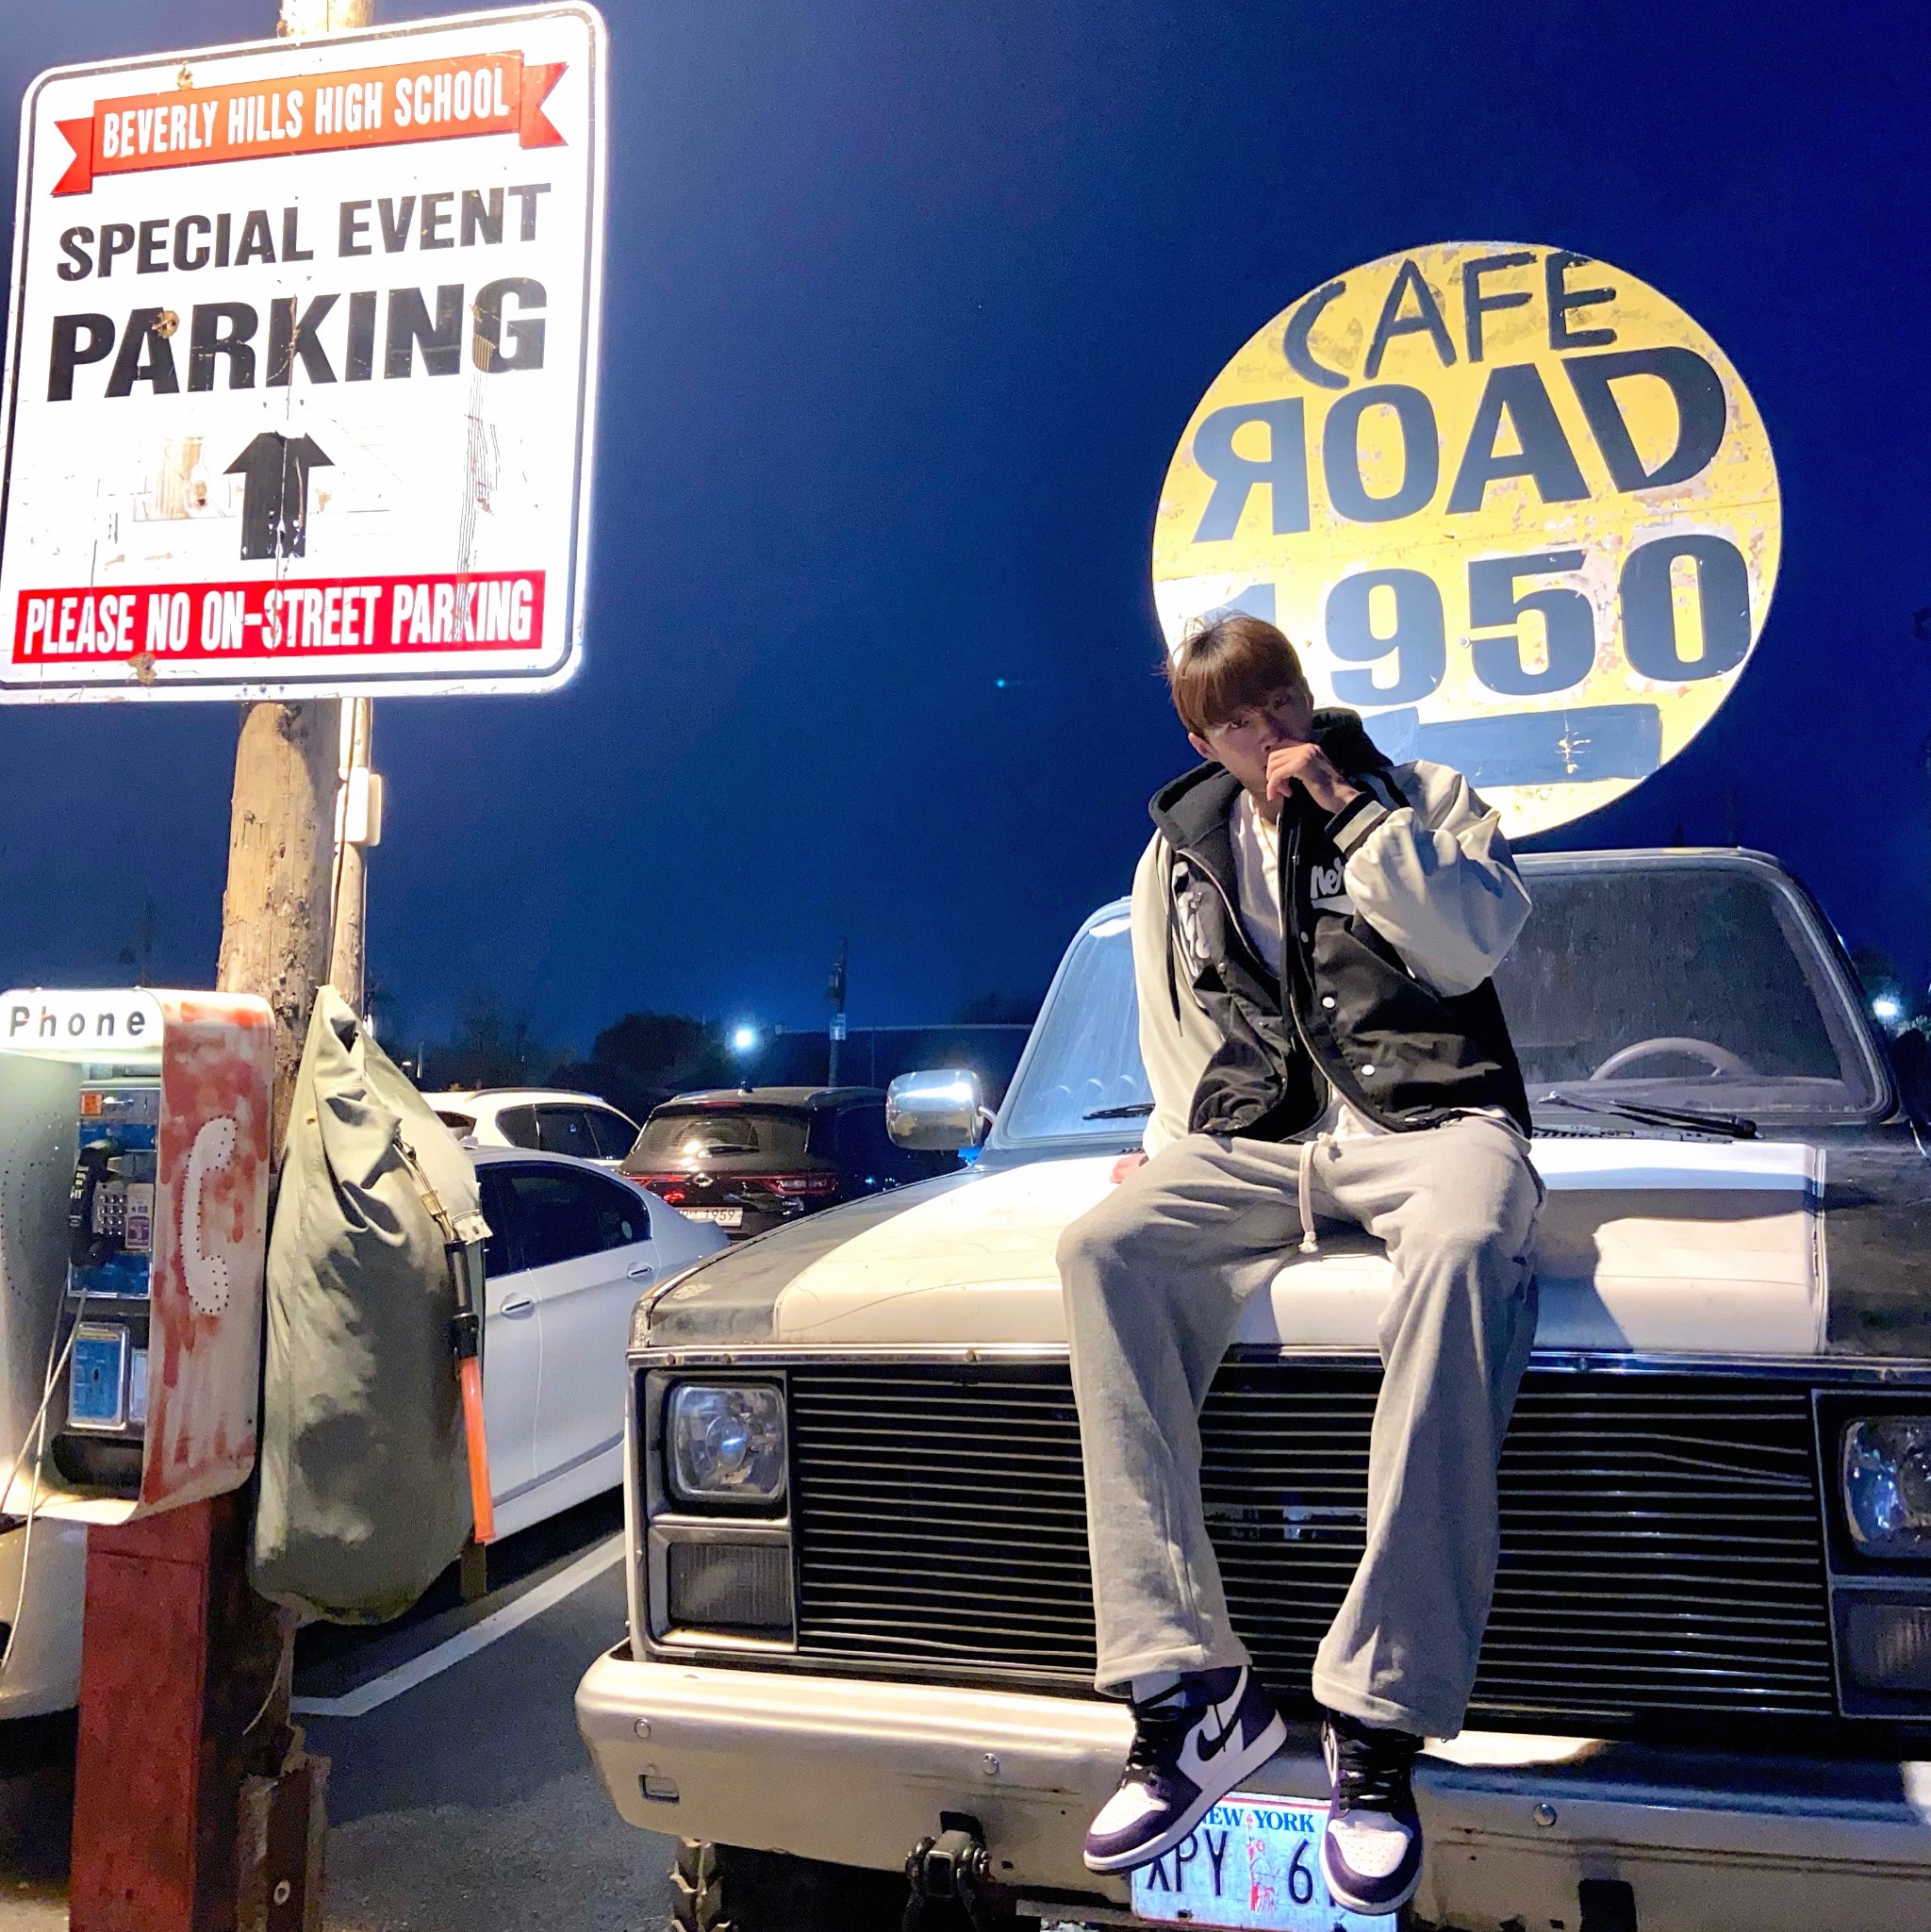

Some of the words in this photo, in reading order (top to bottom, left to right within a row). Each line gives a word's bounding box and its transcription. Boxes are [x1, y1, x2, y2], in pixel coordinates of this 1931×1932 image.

[103, 101, 218, 158] BEVERLY
[227, 90, 303, 145] HILLS
[315, 81, 383, 135] HIGH
[395, 67, 509, 127] SCHOOL
[57, 206, 314, 282] SPECIAL
[338, 182, 552, 257] EVENT
[47, 276, 547, 402] PARKING
[1283, 251, 1617, 389] CAFE
[1192, 346, 1726, 544] ROAD
[24, 590, 136, 655] PLEASE
[145, 590, 190, 652] NO
[201, 586, 383, 651] ON-STREET
[391, 579, 532, 645] PARKING
[8, 1005, 146, 1038] Phone
[704, 1209, 734, 1221] 1959
[1201, 1807, 1244, 1826] EW
[1252, 1809, 1314, 1833] YORK
